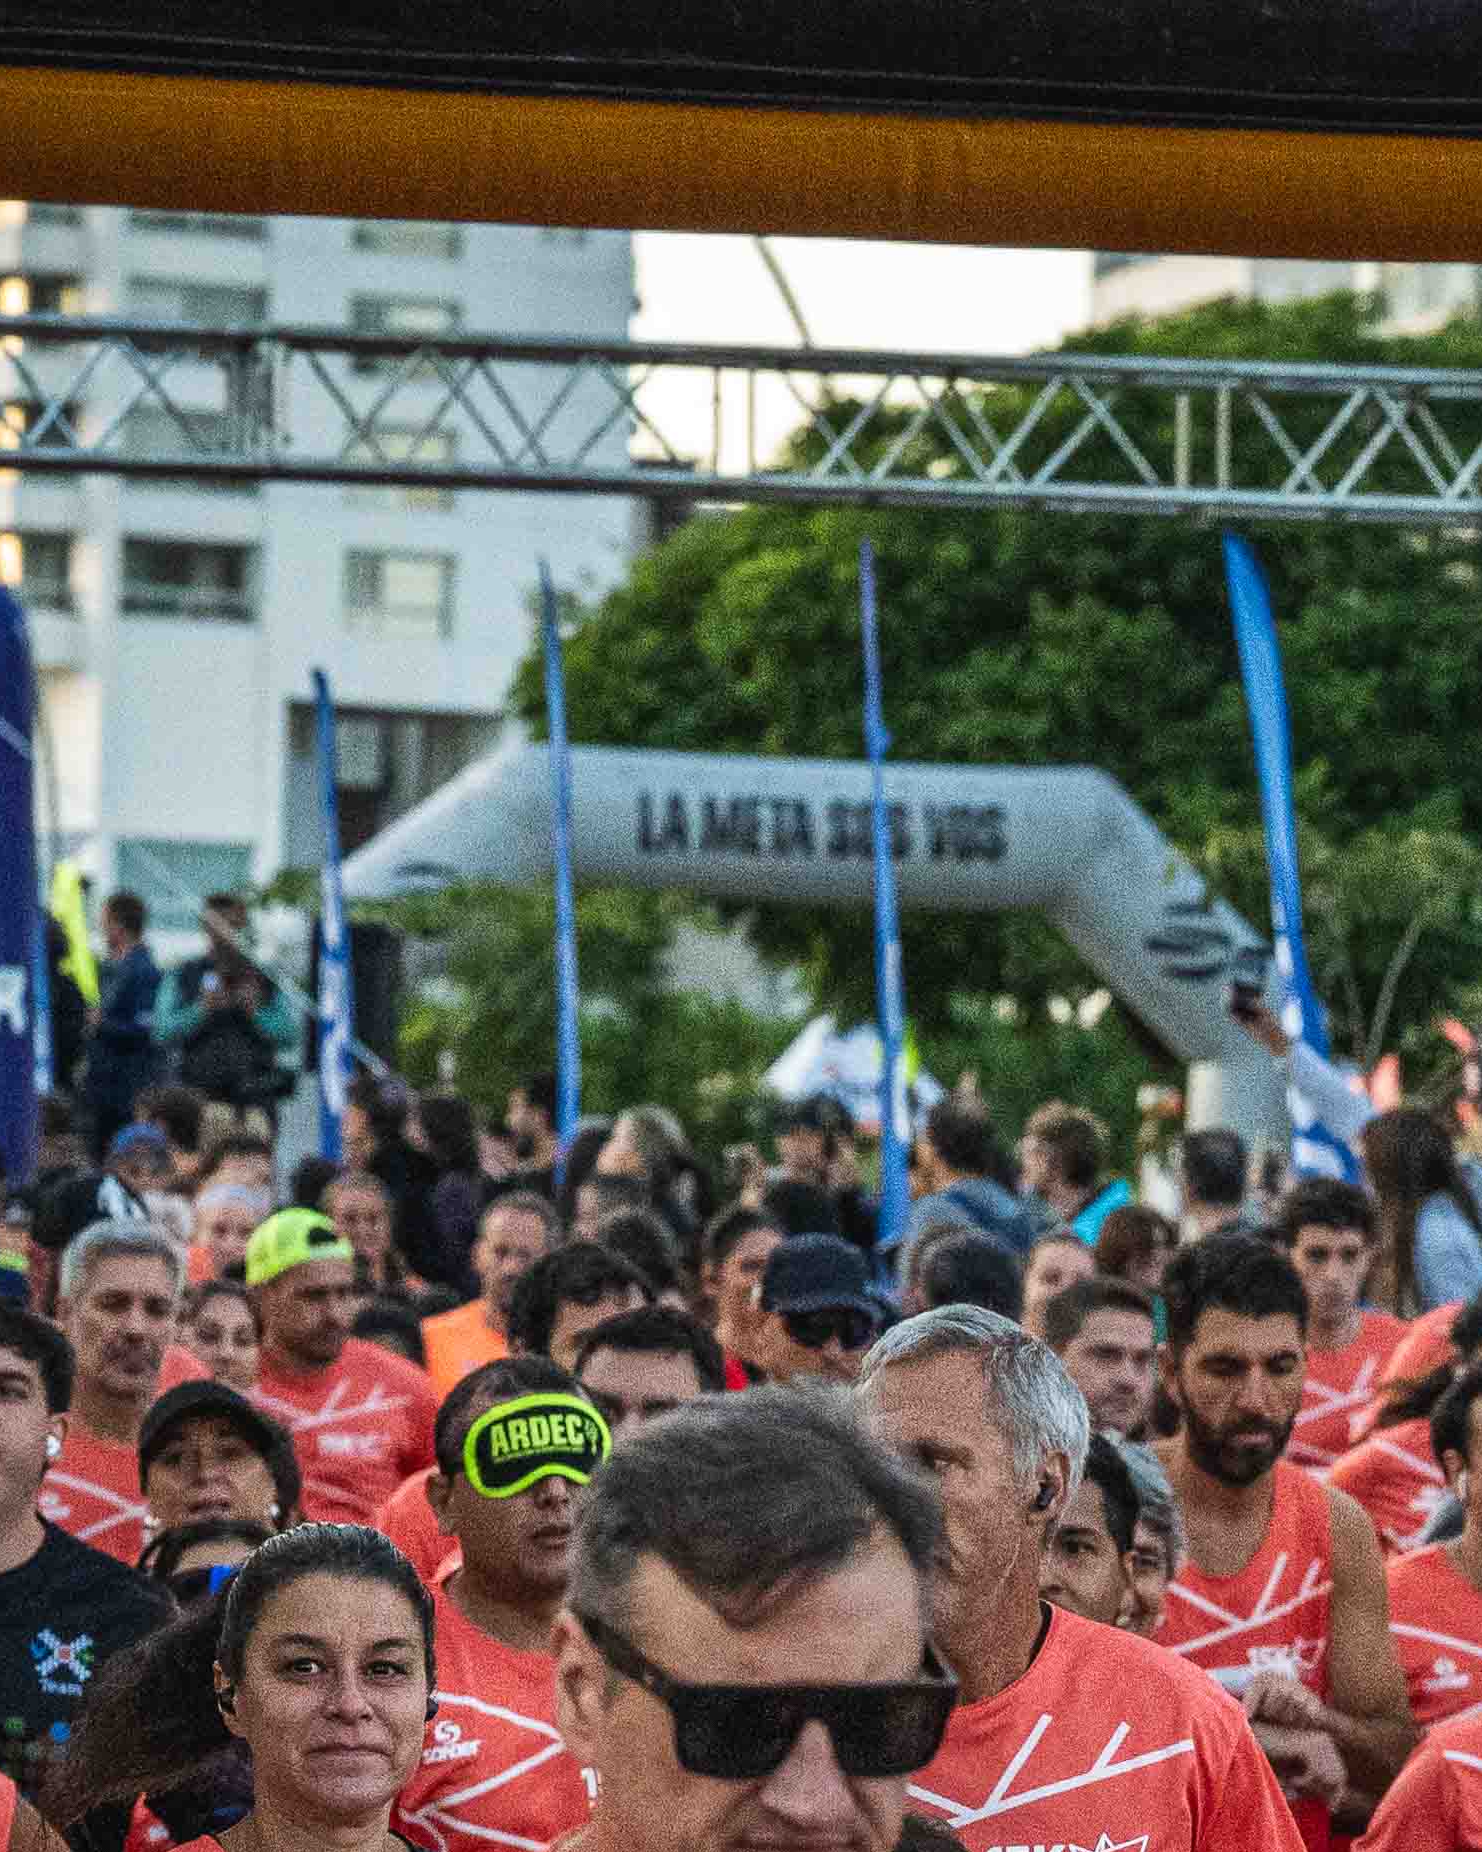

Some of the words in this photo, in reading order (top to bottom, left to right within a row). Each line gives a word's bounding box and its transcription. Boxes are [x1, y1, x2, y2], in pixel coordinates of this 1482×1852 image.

[637, 790, 687, 851] LA
[699, 790, 816, 853] META
[923, 800, 1008, 861] VOS
[490, 1412, 585, 1457] ARDEC
